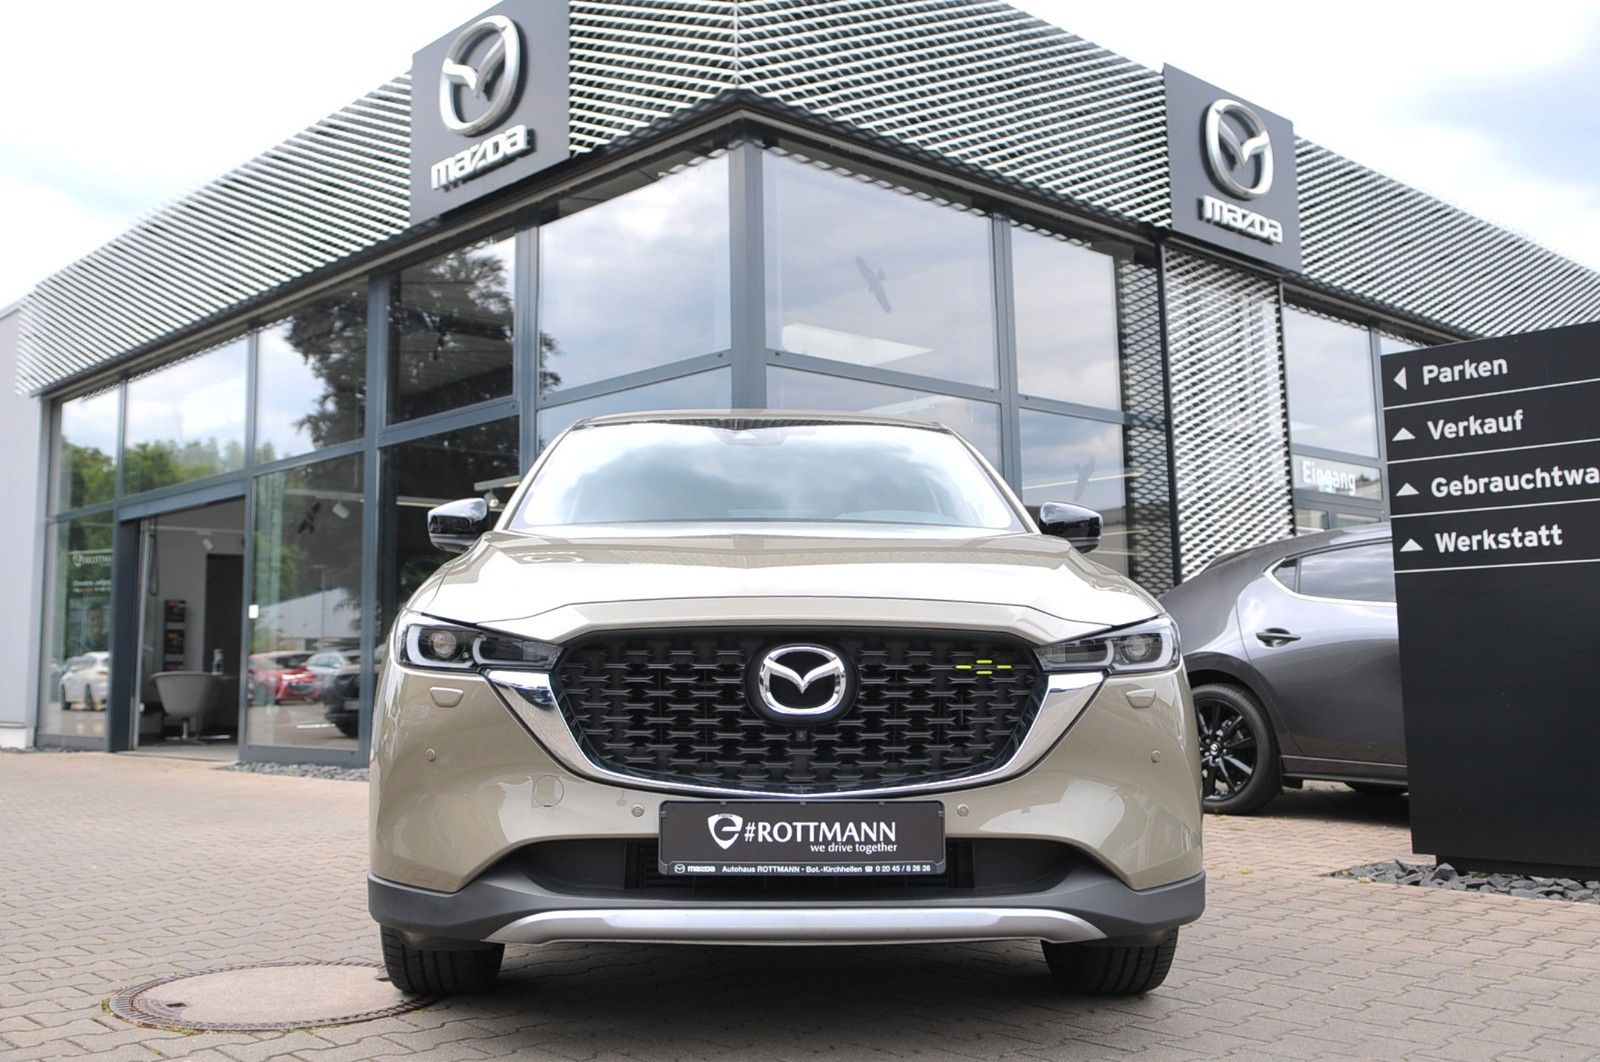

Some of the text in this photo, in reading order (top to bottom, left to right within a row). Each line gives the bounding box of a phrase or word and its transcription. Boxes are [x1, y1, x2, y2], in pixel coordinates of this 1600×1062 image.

[1422, 358, 1508, 385] Parken
[1427, 409, 1523, 440] Verkauf
[1302, 461, 1356, 496] Eingang
[1431, 465, 1600, 498] Gebrauchtwa
[1434, 524, 1563, 553] Werkstatt
[744, 821, 896, 842] #ROTTMANN
[810, 842, 898, 855] we drive together
[722, 865, 756, 873] Autohaus
[757, 865, 800, 873] ROTTMANN
